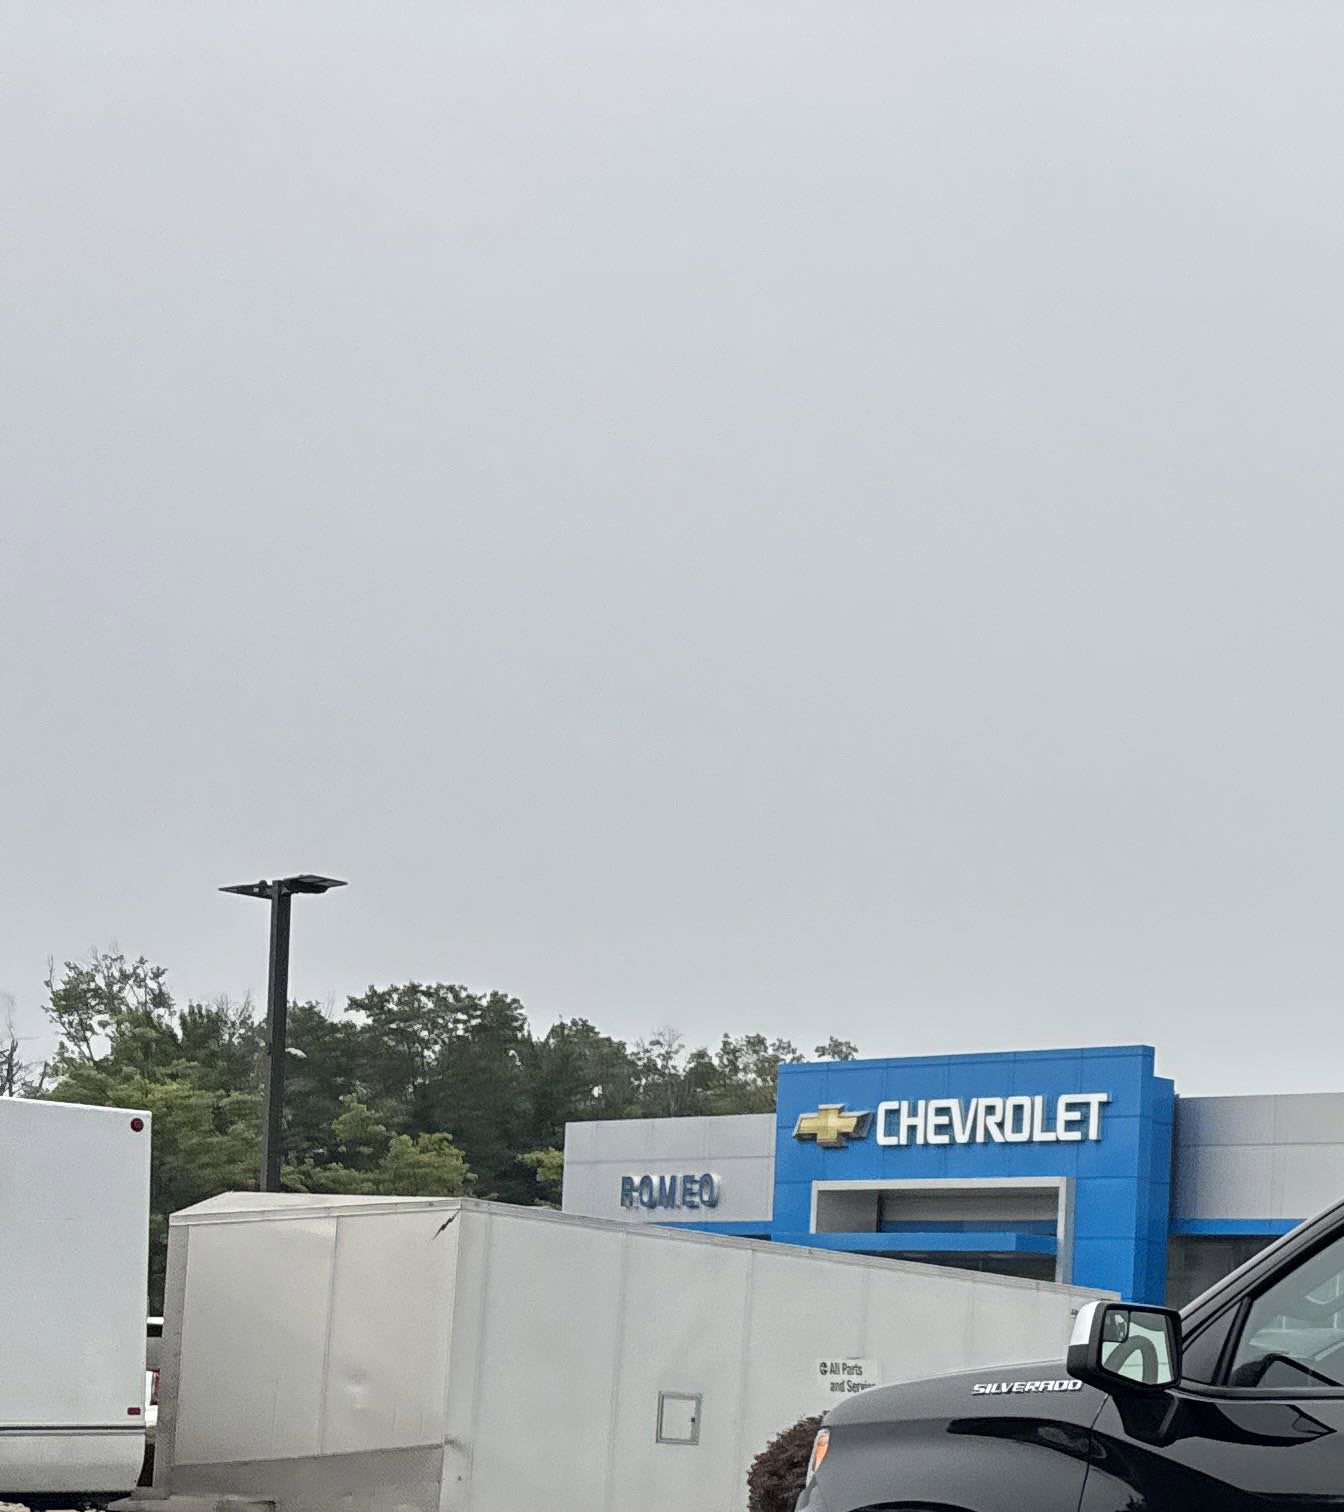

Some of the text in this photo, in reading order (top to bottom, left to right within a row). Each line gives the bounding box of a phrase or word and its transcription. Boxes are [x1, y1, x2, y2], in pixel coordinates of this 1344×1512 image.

[875, 1093, 1112, 1147] CHEVROLET
[620, 1173, 719, 1210] ROMEO
[841, 1362, 863, 1376] Parts
[971, 1378, 1084, 1395] SILVERADO
